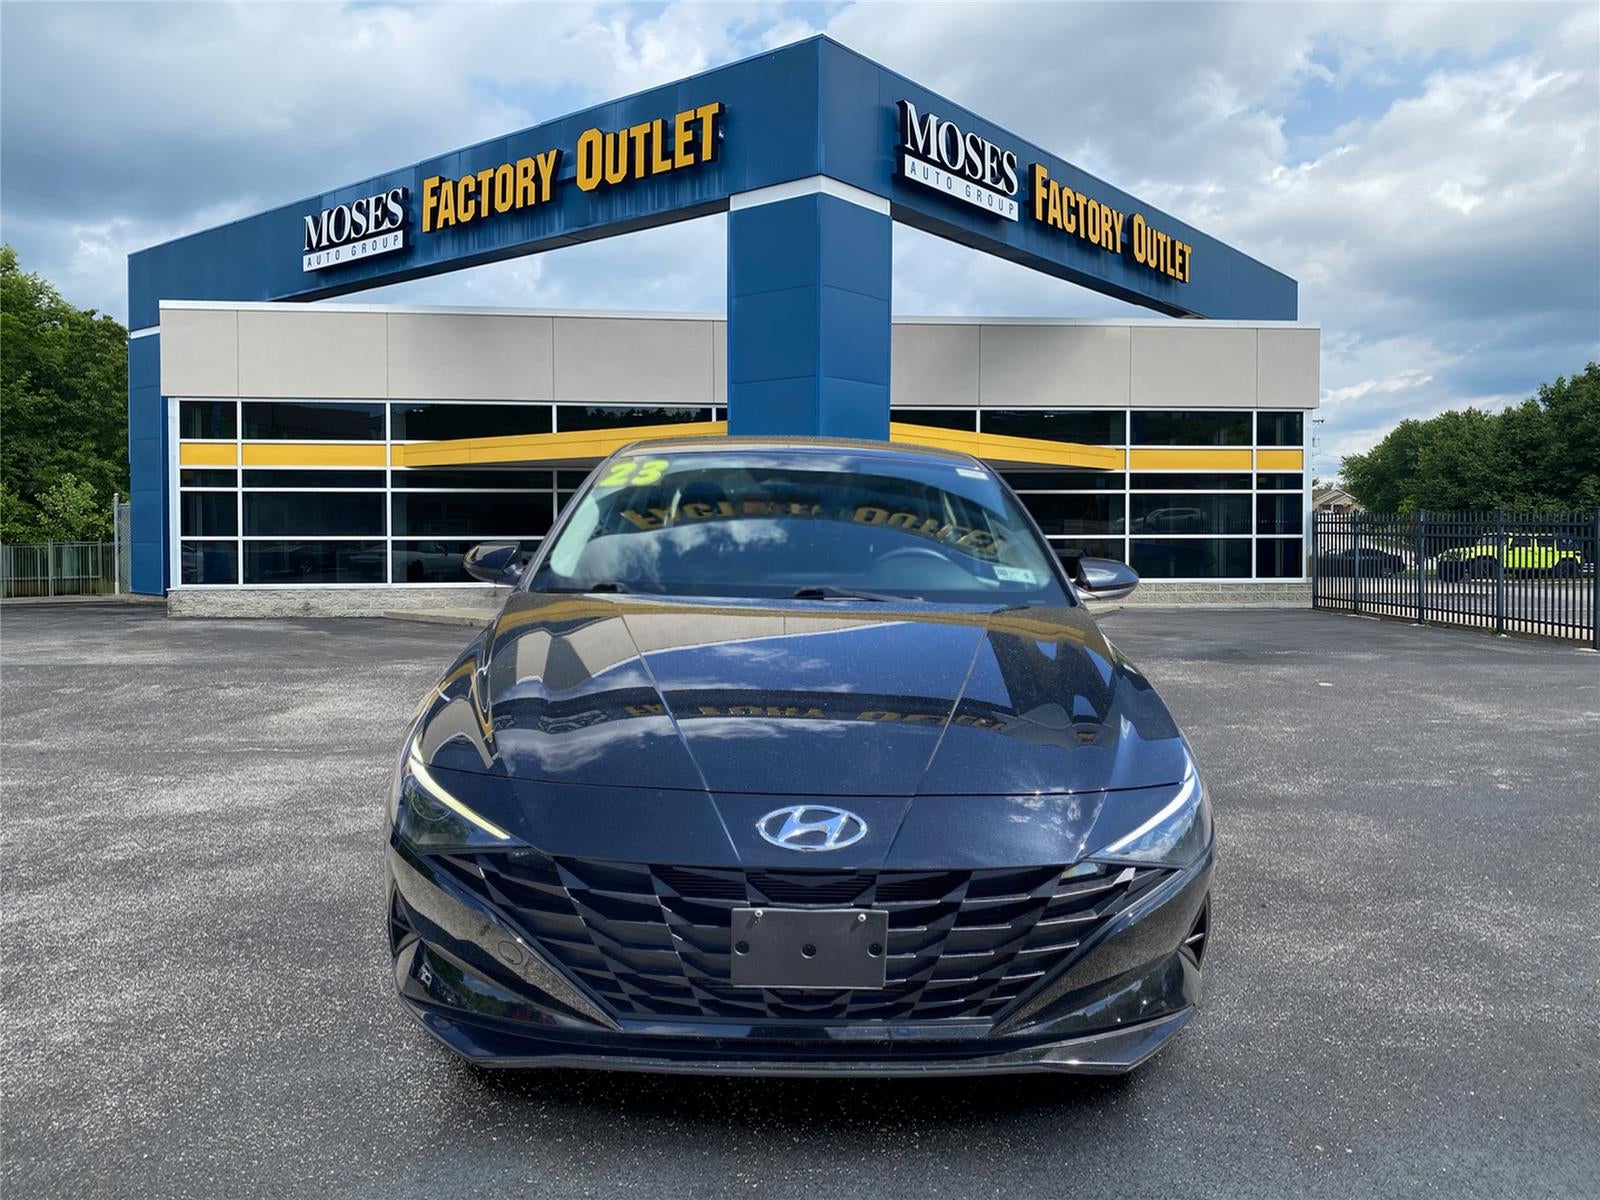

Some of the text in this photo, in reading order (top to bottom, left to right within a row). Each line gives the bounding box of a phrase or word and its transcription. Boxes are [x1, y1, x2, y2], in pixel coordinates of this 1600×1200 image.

[422, 102, 720, 232] FACTORY OUTLET
[902, 99, 1018, 196] MOSES
[303, 187, 404, 251] MOSES
[909, 160, 1014, 215] AUTO GROUP
[307, 234, 399, 268] AUTO GROUP
[1034, 163, 1192, 283] FACTORY OUTLET
[600, 460, 669, 487] 23
